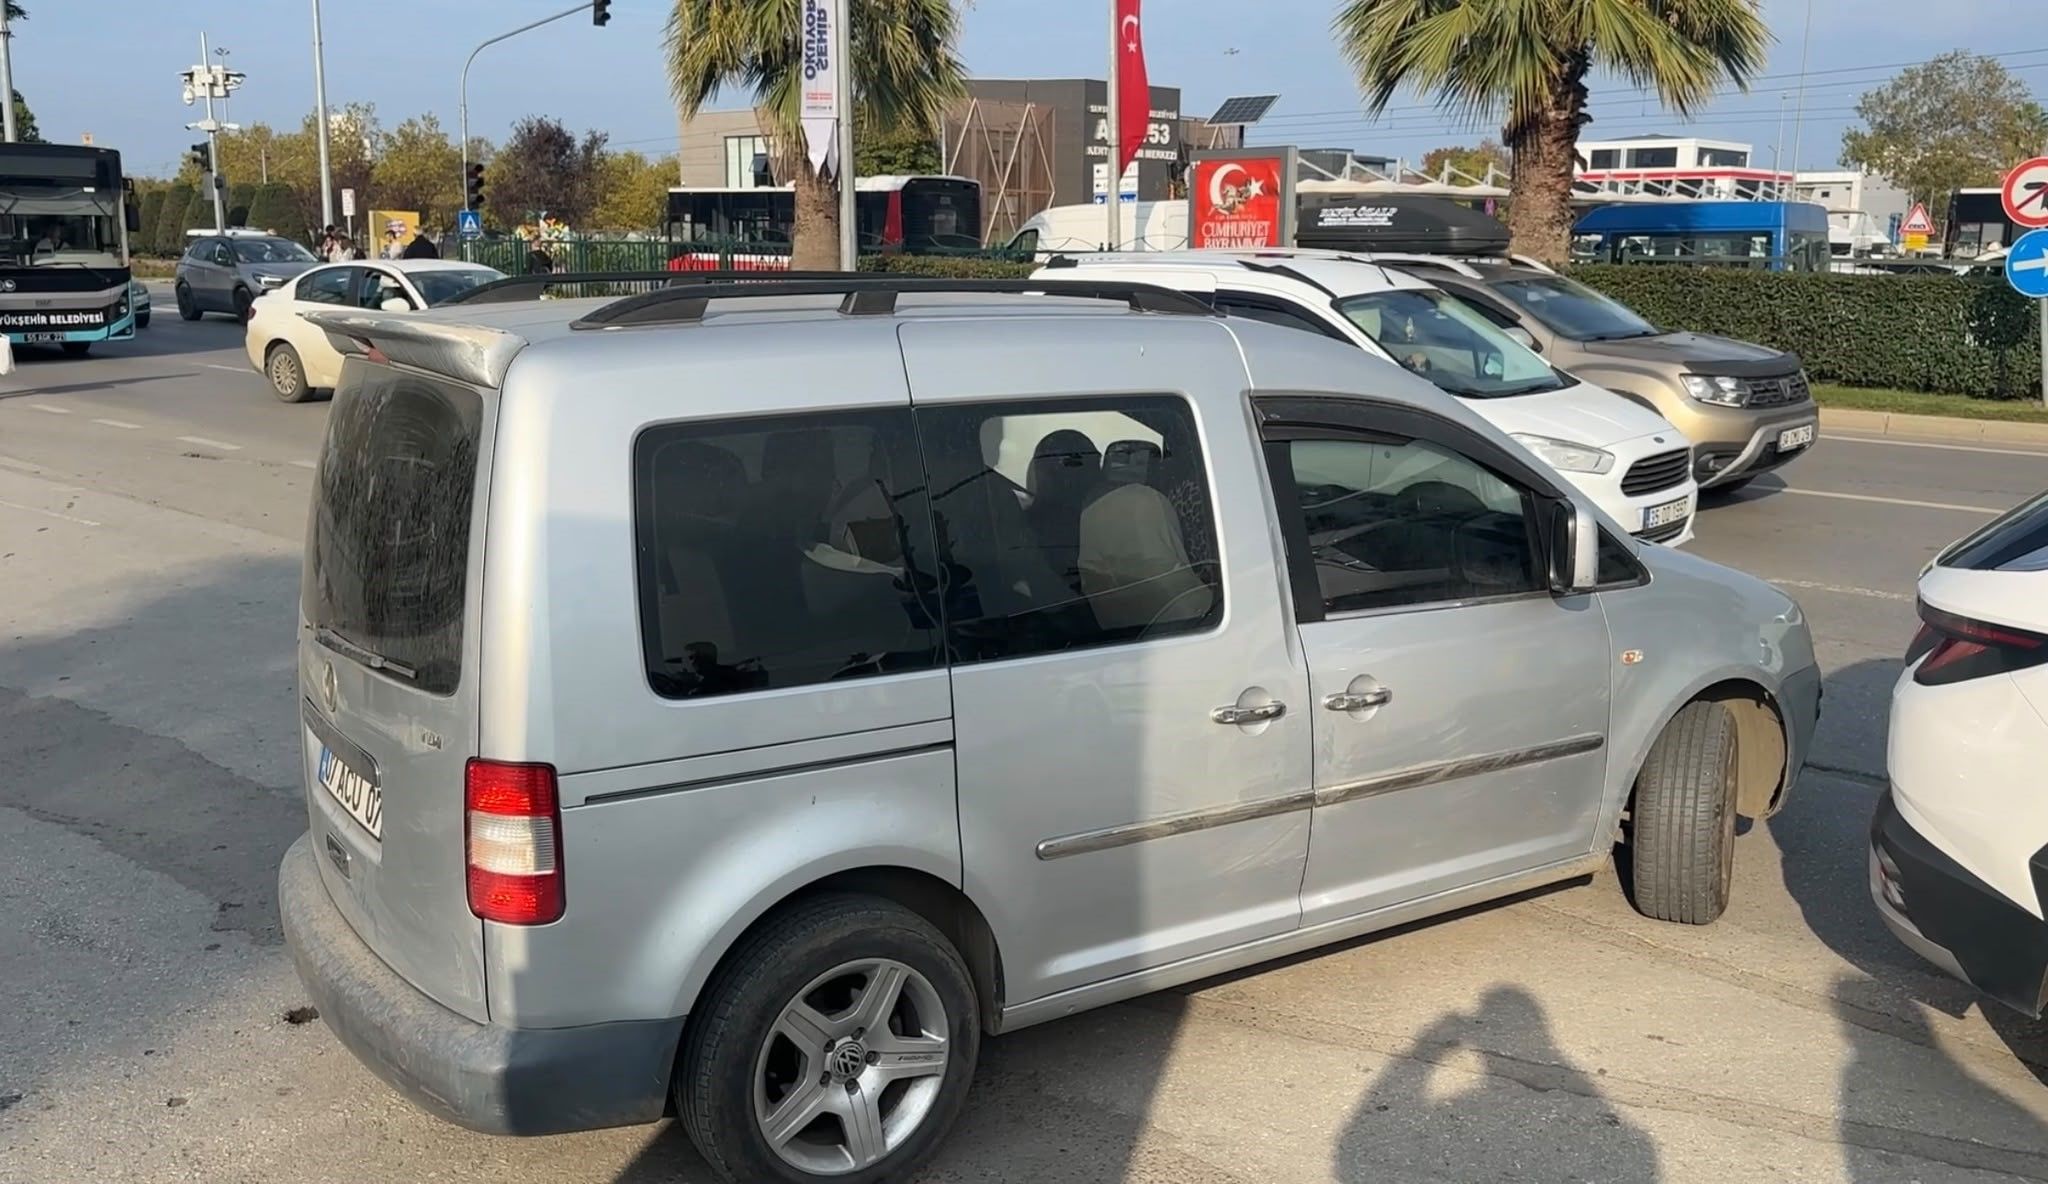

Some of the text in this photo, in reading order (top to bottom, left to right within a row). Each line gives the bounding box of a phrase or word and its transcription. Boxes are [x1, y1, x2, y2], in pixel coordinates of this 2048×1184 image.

[1142, 123, 1170, 144] 53
[1202, 220, 1271, 237] CUMHURİYET
[50, 311, 104, 324] BELEDİYESİ
[337, 763, 364, 812] ACU
